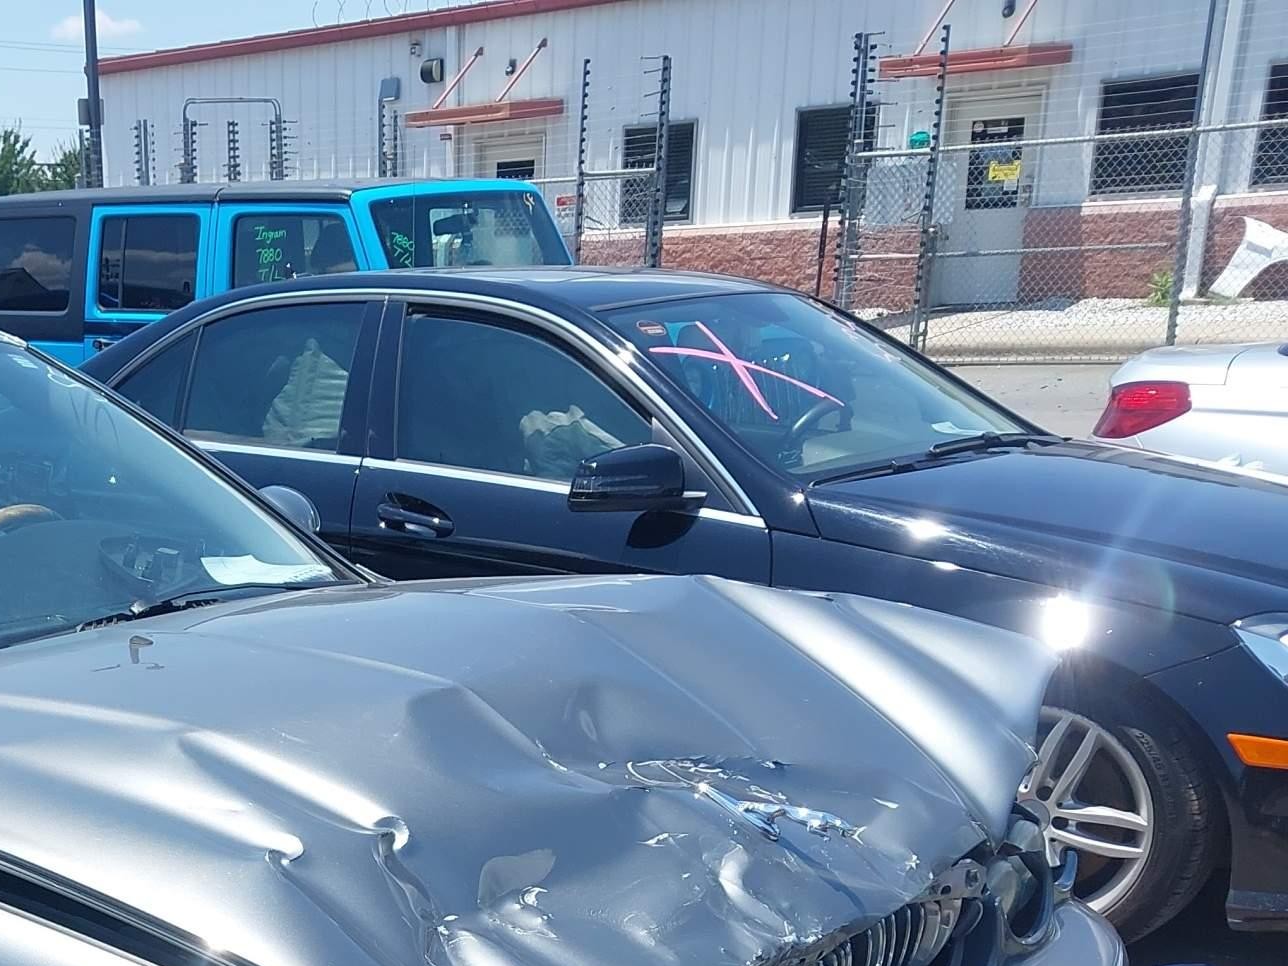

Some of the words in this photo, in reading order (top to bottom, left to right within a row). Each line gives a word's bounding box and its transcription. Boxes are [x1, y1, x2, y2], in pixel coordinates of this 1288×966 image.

[254, 225, 287, 244] Ingram
[391, 232, 415, 251] 7880
[256, 248, 282, 264] 7880
